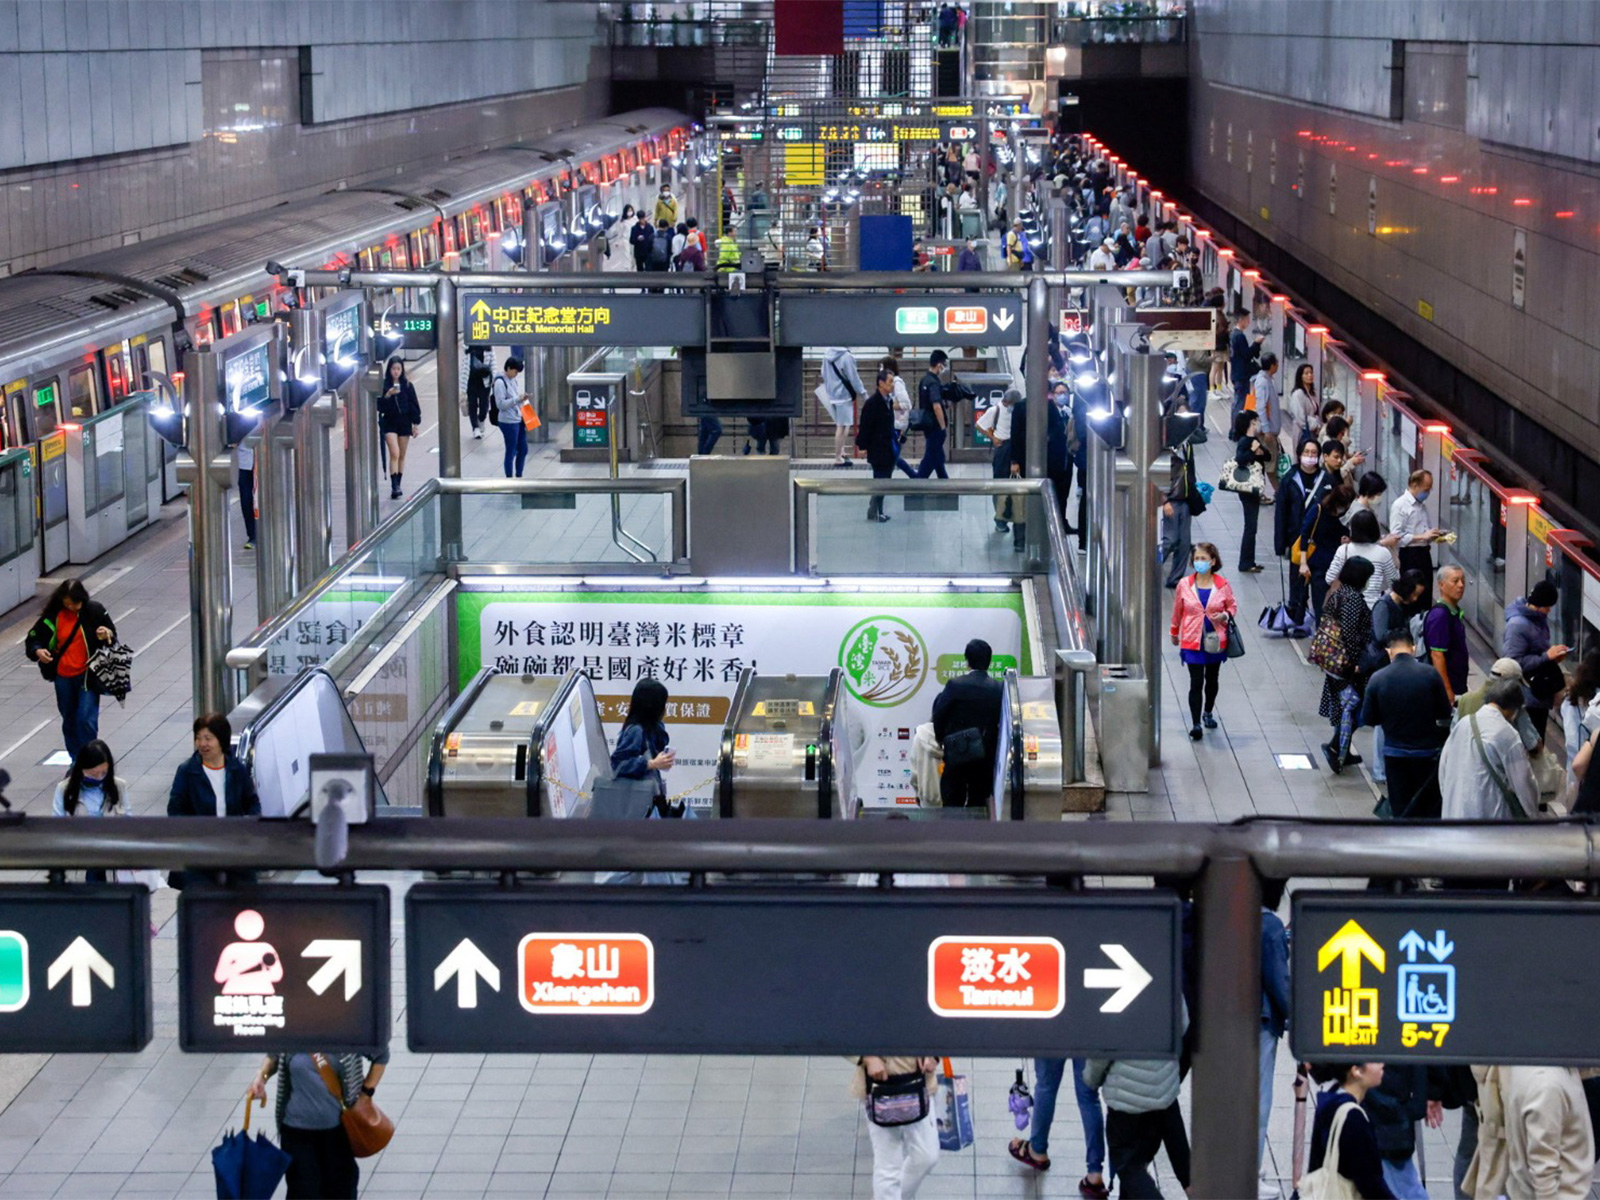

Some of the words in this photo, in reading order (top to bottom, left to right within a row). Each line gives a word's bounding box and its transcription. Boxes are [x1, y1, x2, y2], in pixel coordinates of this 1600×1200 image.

[403, 319, 432, 331] 11:33
[492, 306, 610, 325] 中正紀念堂方向
[493, 324, 505, 334] To
[506, 324, 534, 334] C.K.S.
[535, 324, 576, 334] Memorial
[577, 324, 595, 334] Hall
[494, 620, 745, 649] 外食認明臺灣米標章
[550, 942, 620, 980] 象山
[960, 947, 1032, 984] 淡水
[532, 982, 640, 1006] Xiangshan
[1323, 987, 1378, 1046] 出口
[233, 1025, 266, 1037] Room
[1350, 1028, 1379, 1045] EXIT
[1401, 1022, 1450, 1048] 5~7
